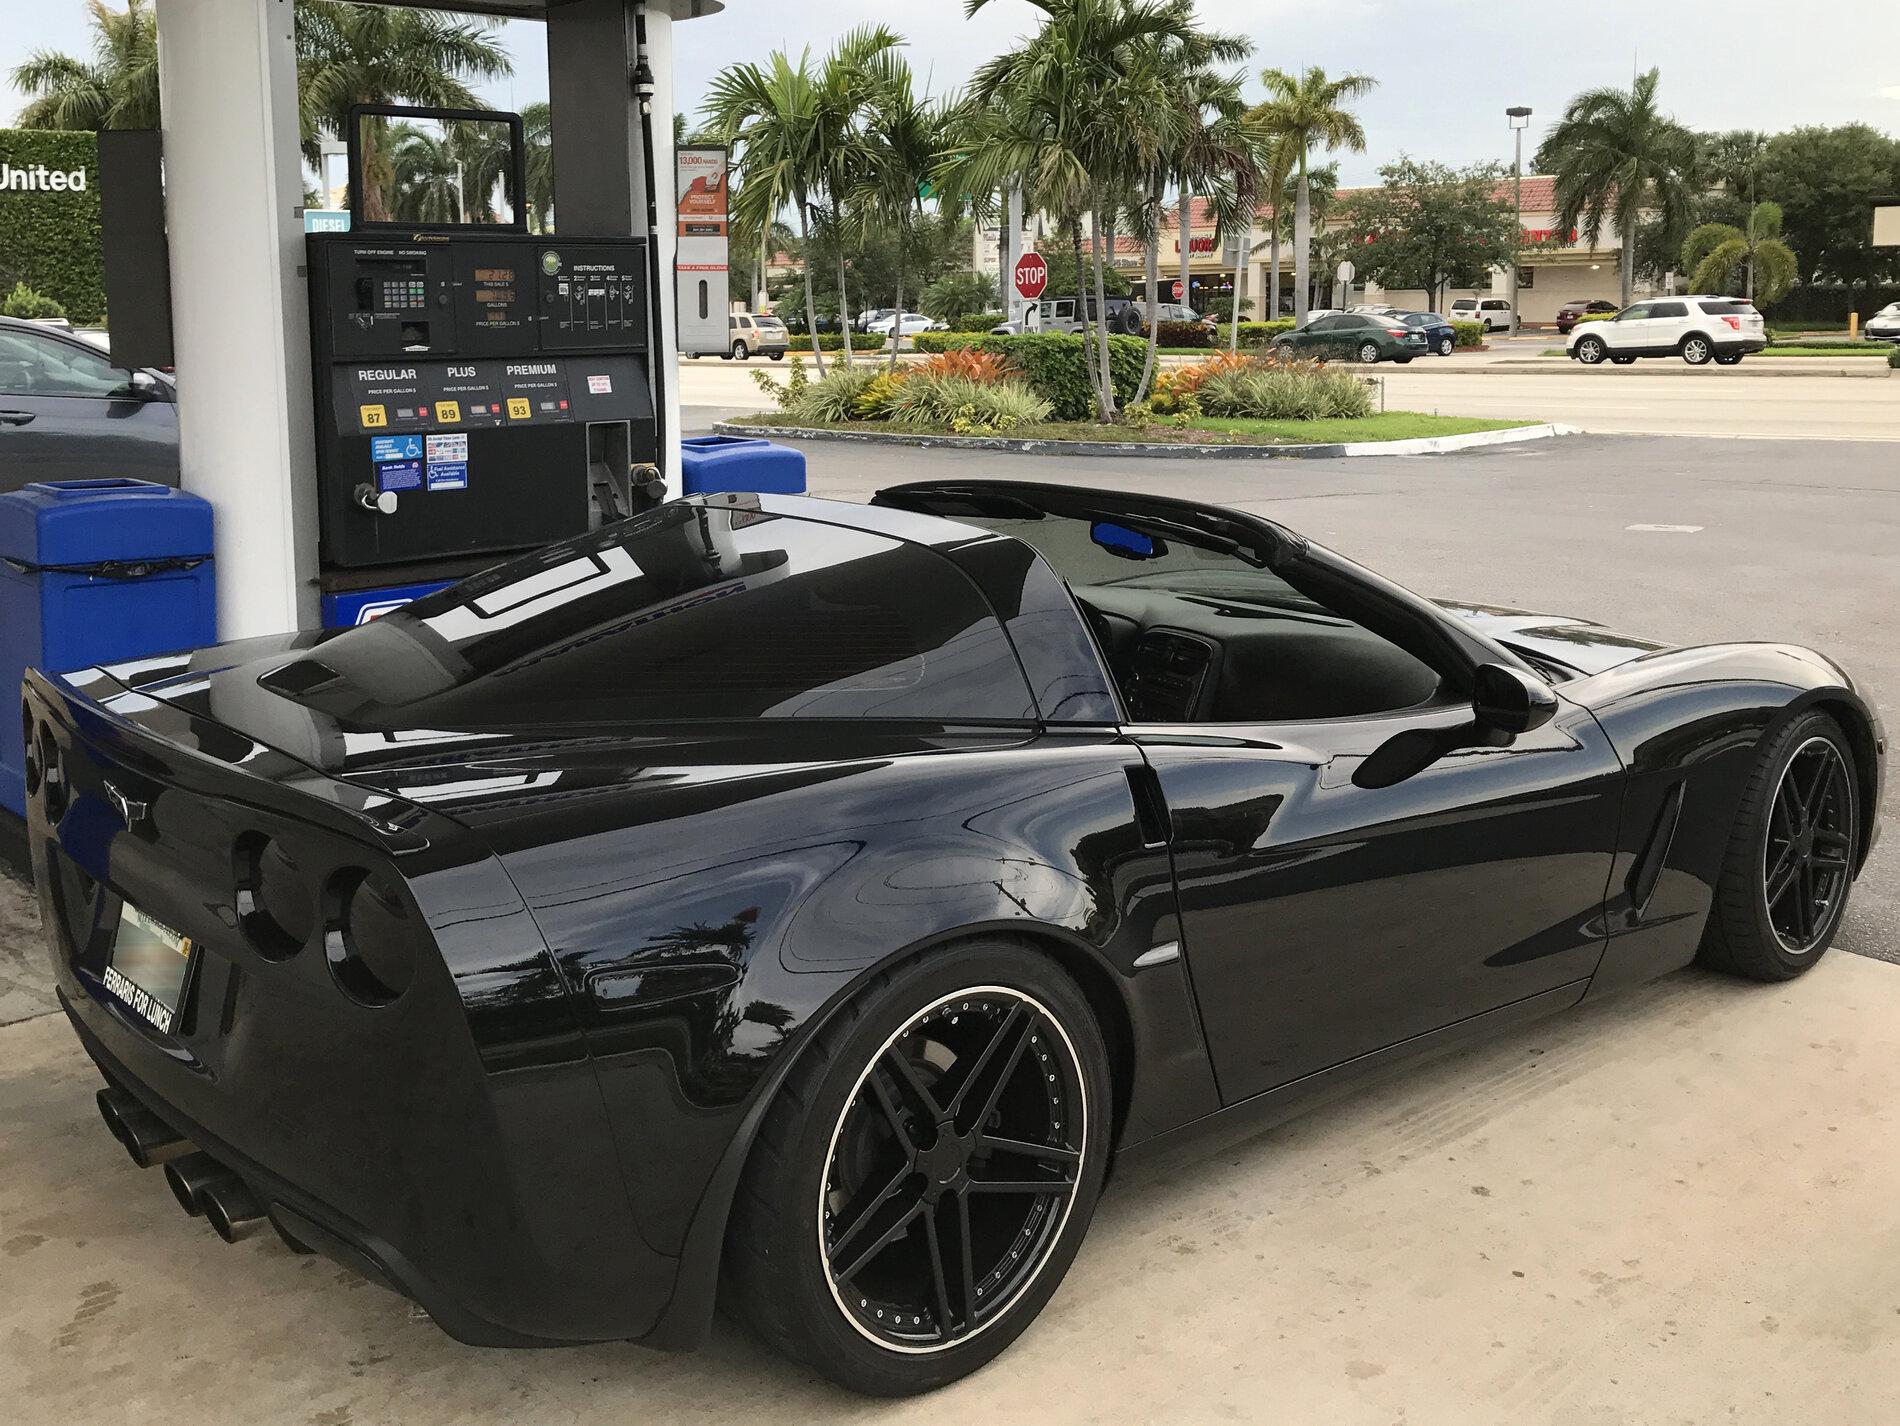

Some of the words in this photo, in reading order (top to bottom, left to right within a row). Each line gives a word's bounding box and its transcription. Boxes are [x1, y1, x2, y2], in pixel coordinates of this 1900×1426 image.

[312, 218, 345, 231] DIESEL
[1016, 266, 1045, 285] STOP
[358, 368, 417, 381] REGULAR
[447, 366, 477, 378] PLUS
[506, 363, 557, 376] PREMIUM
[441, 409, 456, 420] 89
[512, 405, 526, 416] 93
[367, 413, 380, 424] 87
[132, 987, 147, 1018] FOR
[145, 997, 173, 1035] LUNCH
